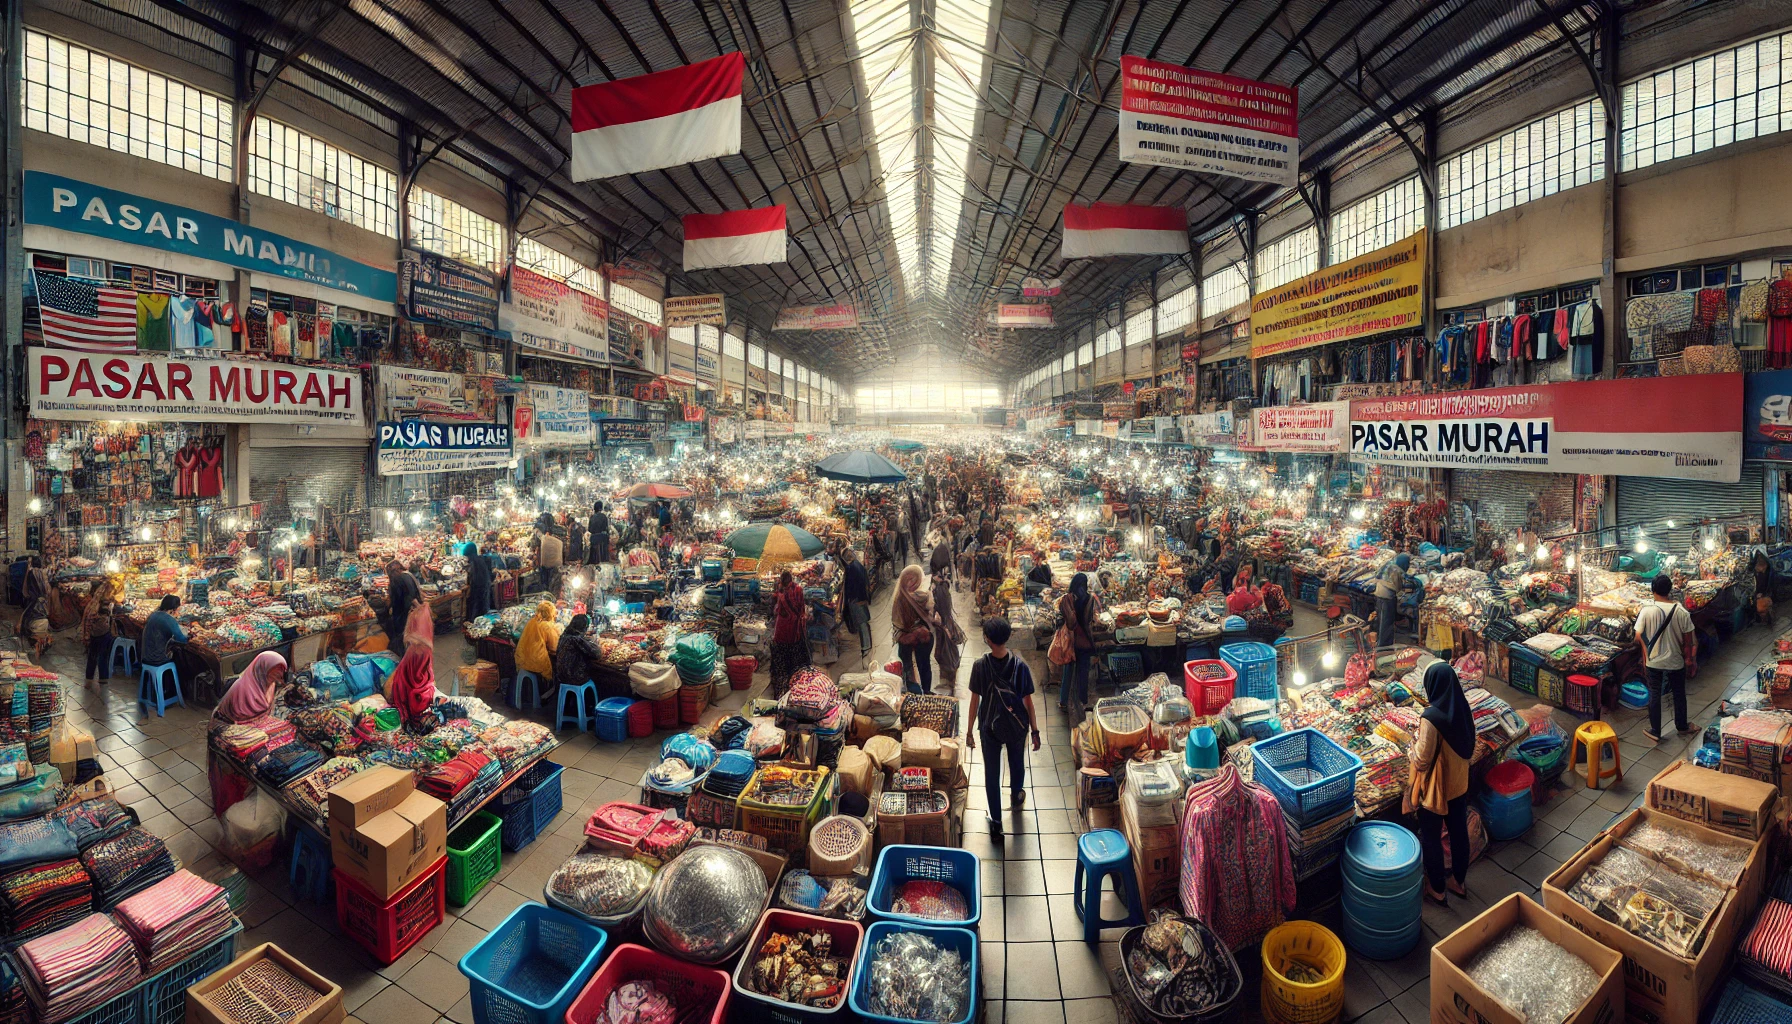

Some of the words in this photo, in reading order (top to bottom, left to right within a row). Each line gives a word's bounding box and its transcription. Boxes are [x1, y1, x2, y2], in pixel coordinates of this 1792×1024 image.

[52, 187, 199, 245] PASAR
[40, 355, 194, 401] PASAR
[209, 365, 351, 408] MURAH
[1352, 423, 1429, 452] PASAR
[1438, 422, 1549, 454] MURAH
